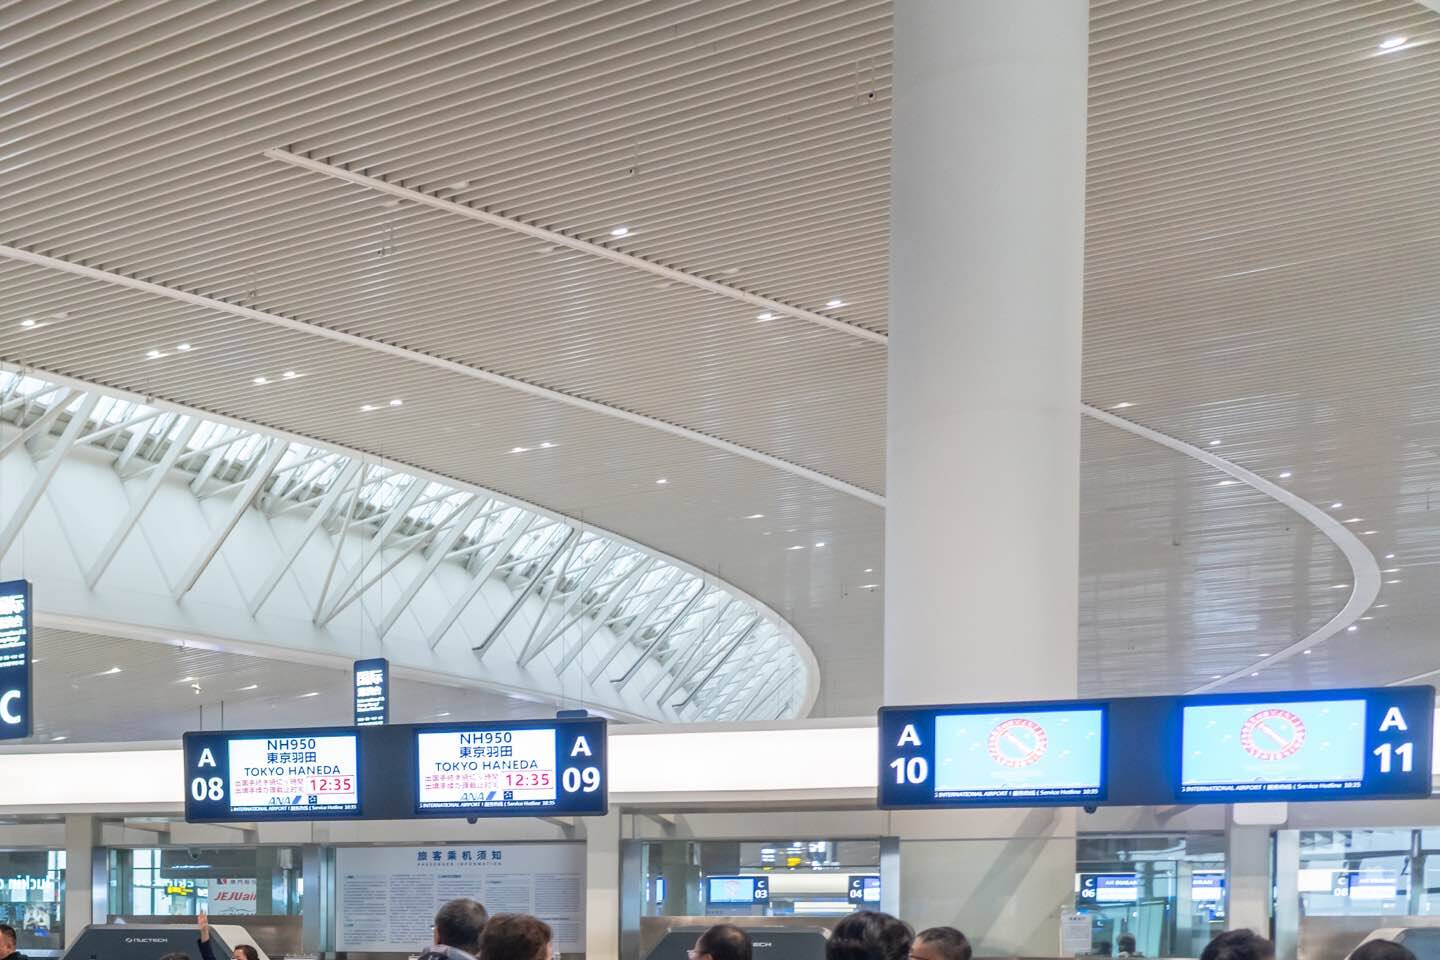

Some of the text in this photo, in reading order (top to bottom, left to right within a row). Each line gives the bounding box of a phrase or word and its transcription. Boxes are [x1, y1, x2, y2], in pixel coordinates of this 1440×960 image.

[0, 690, 21, 724] C
[1381, 707, 1408, 731] A
[460, 732, 512, 744] NH950
[897, 724, 922, 746] A
[267, 739, 315, 750] NH950
[572, 737, 591, 757] A
[198, 749, 216, 767] A
[267, 752, 316, 763] 東京羽田
[460, 746, 512, 758] 東京羽田
[1373, 743, 1413, 772] 11
[244, 766, 340, 776] TOKYO HANEDA
[435, 760, 538, 771] TOKYO HANEDA
[890, 757, 928, 784] 10
[311, 779, 351, 790] 12:35
[506, 774, 549, 786] 12:35
[563, 768, 600, 792] 09
[191, 777, 224, 800] 08
[1085, 879, 1093, 887] C
[755, 890, 768, 898] 03
[850, 890, 863, 898] 04
